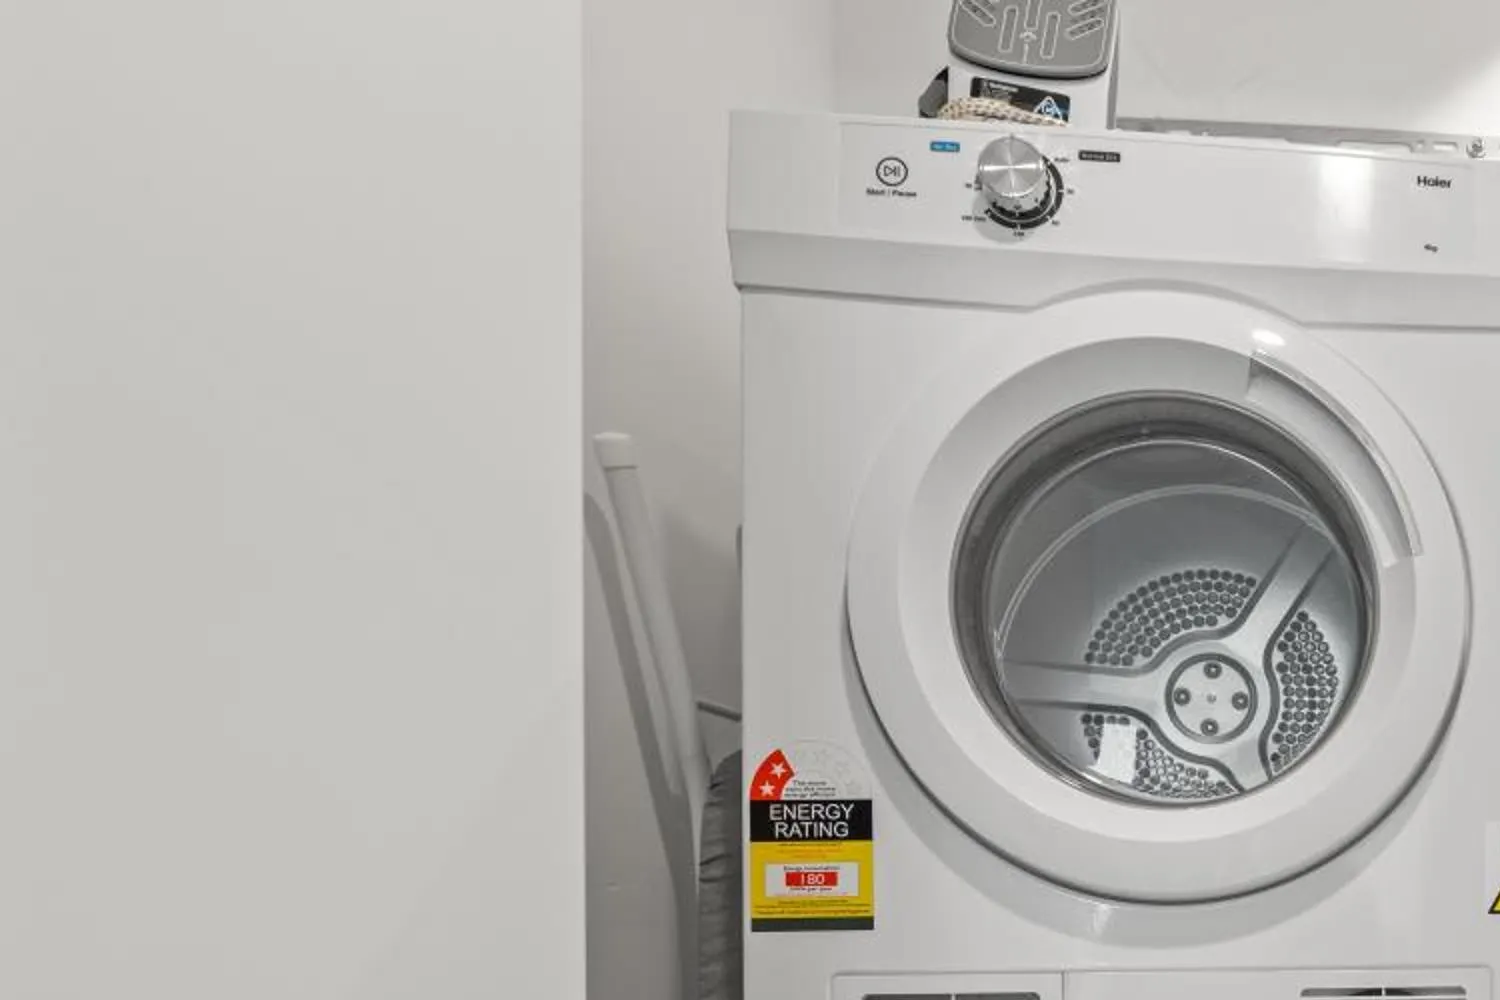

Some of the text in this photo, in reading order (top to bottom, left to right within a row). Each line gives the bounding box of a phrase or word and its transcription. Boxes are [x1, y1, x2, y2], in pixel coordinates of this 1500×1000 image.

[1417, 175, 1452, 188] Haier
[769, 803, 855, 821] ENERGY
[774, 821, 849, 839] RATING
[800, 873, 825, 885] 180
